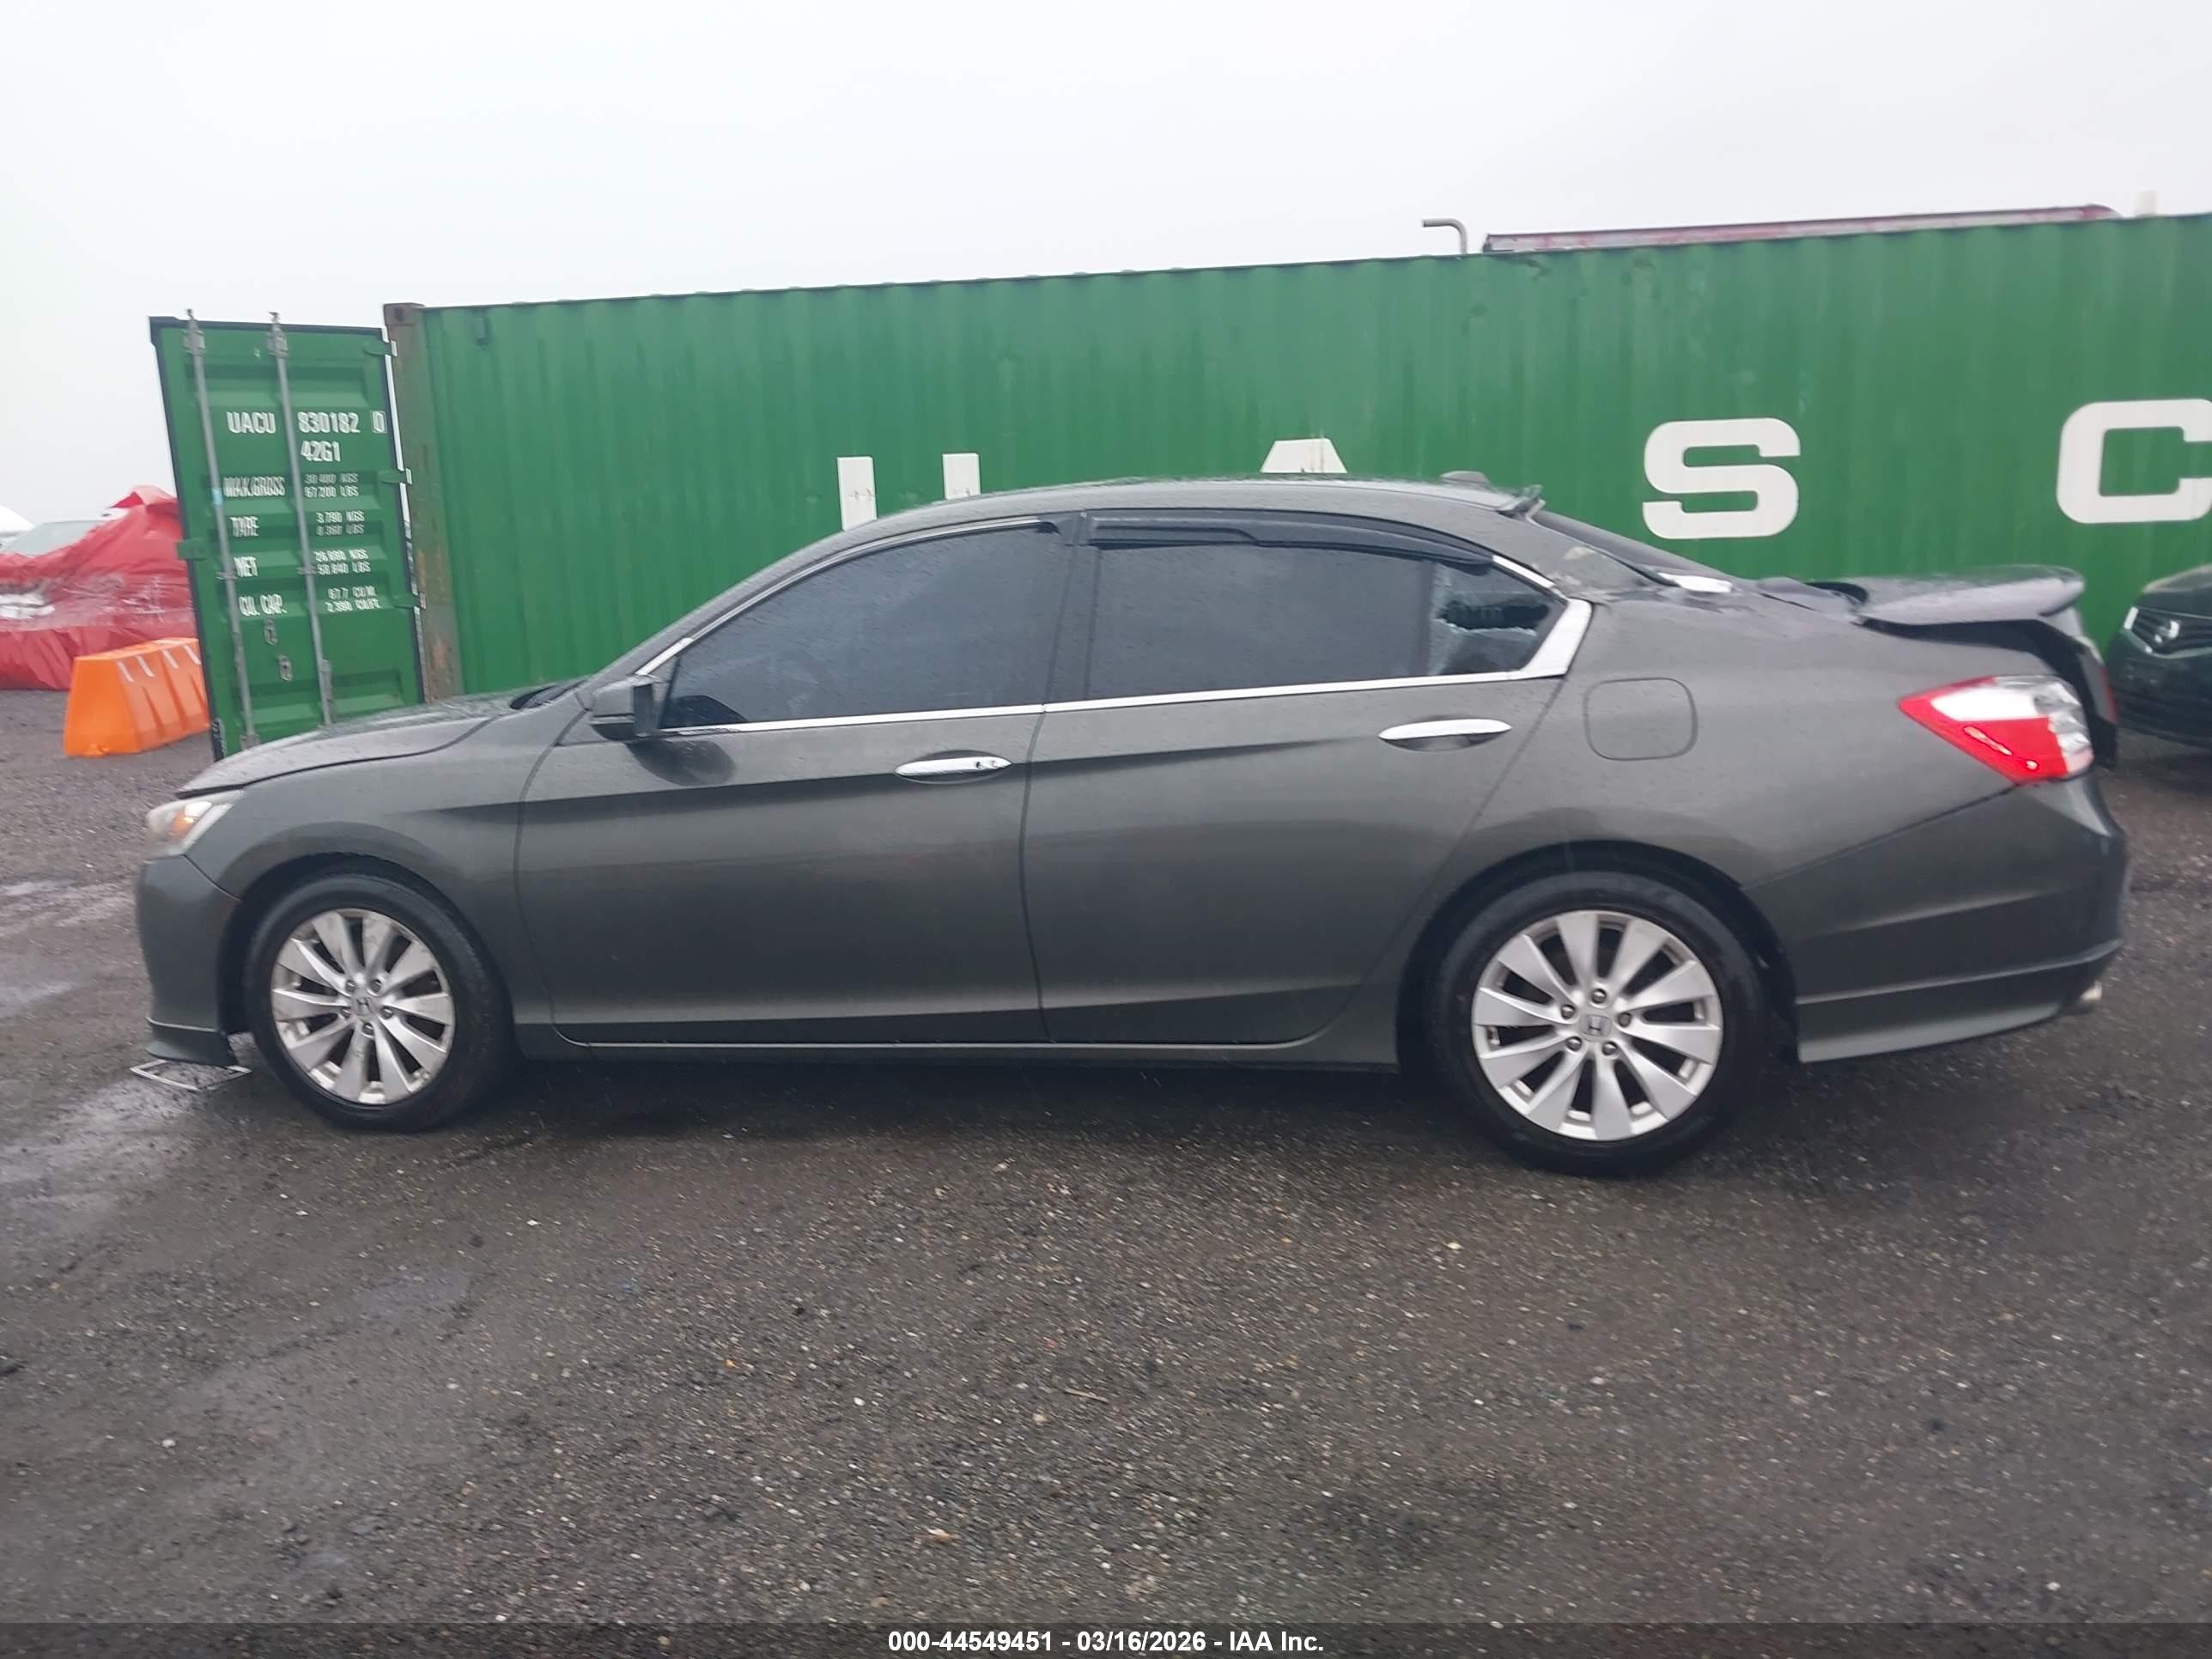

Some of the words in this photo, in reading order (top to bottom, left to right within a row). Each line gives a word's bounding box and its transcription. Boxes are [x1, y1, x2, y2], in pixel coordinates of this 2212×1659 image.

[226, 411, 276, 434] UACU
[298, 411, 361, 433] 830182
[301, 440, 341, 462] 42G1
[230, 515, 259, 538] TARE
[234, 556, 258, 578] NET
